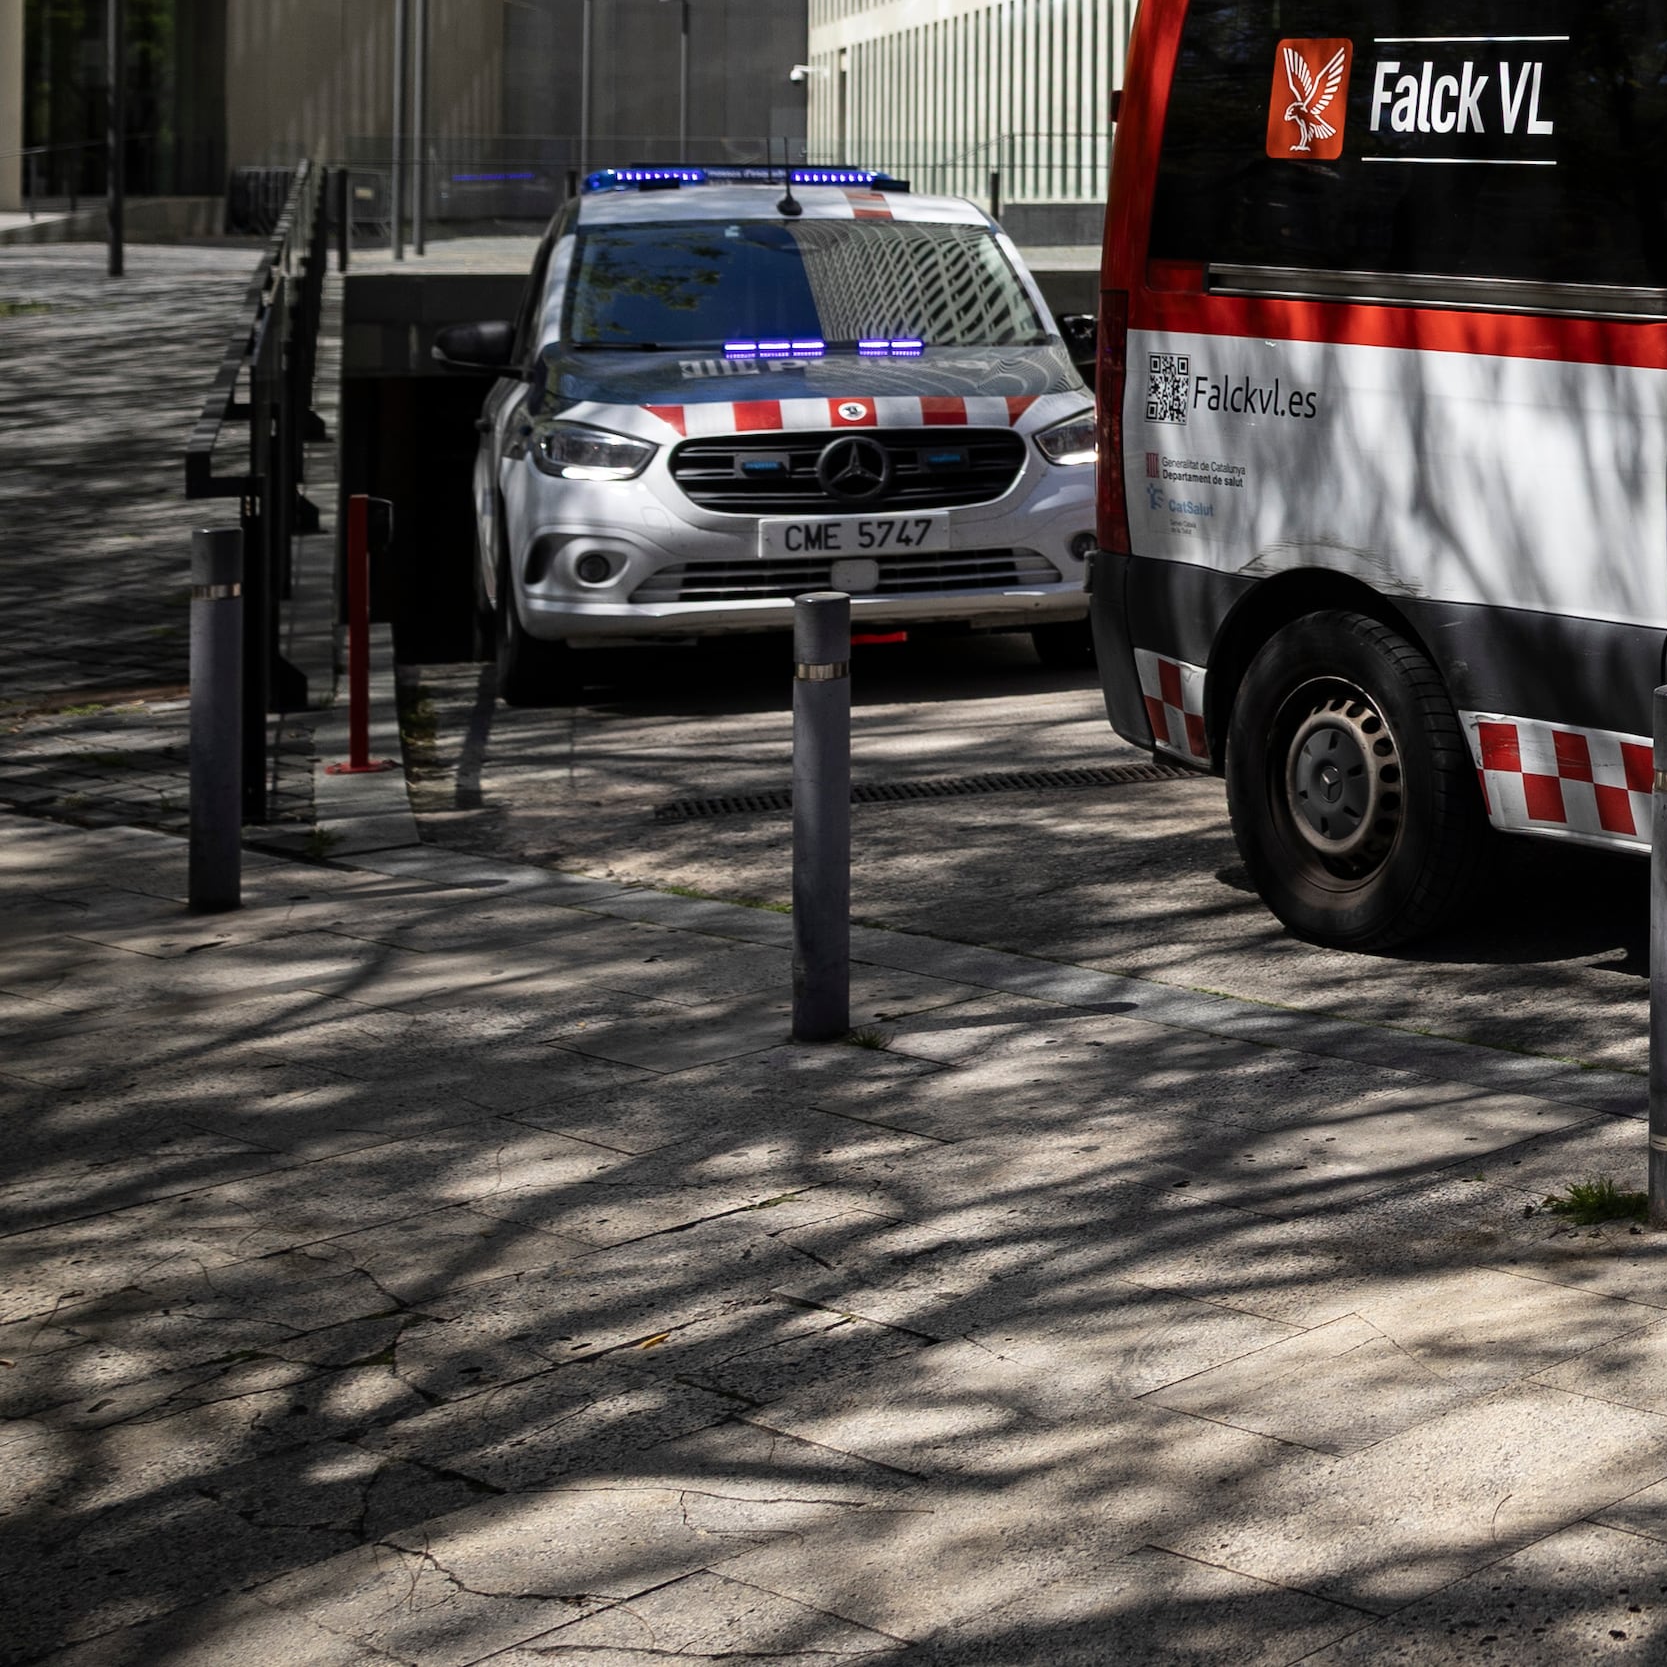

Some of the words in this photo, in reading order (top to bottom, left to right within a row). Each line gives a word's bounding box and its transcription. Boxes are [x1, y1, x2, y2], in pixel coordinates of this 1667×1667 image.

[1370, 61, 1489, 133] Falck
[1499, 61, 1554, 135] VL
[1193, 375, 1317, 418] Falckvl.es
[1161, 456, 1199, 471] Generalitat
[1200, 460, 1210, 471] de
[1211, 461, 1246, 477] Catalunya
[1162, 469, 1211, 484] Departament
[1213, 475, 1222, 486] de
[1225, 476, 1243, 487] salut
[1168, 499, 1213, 516] CatSalut
[784, 523, 841, 552] CME
[858, 519, 932, 549] 5747
